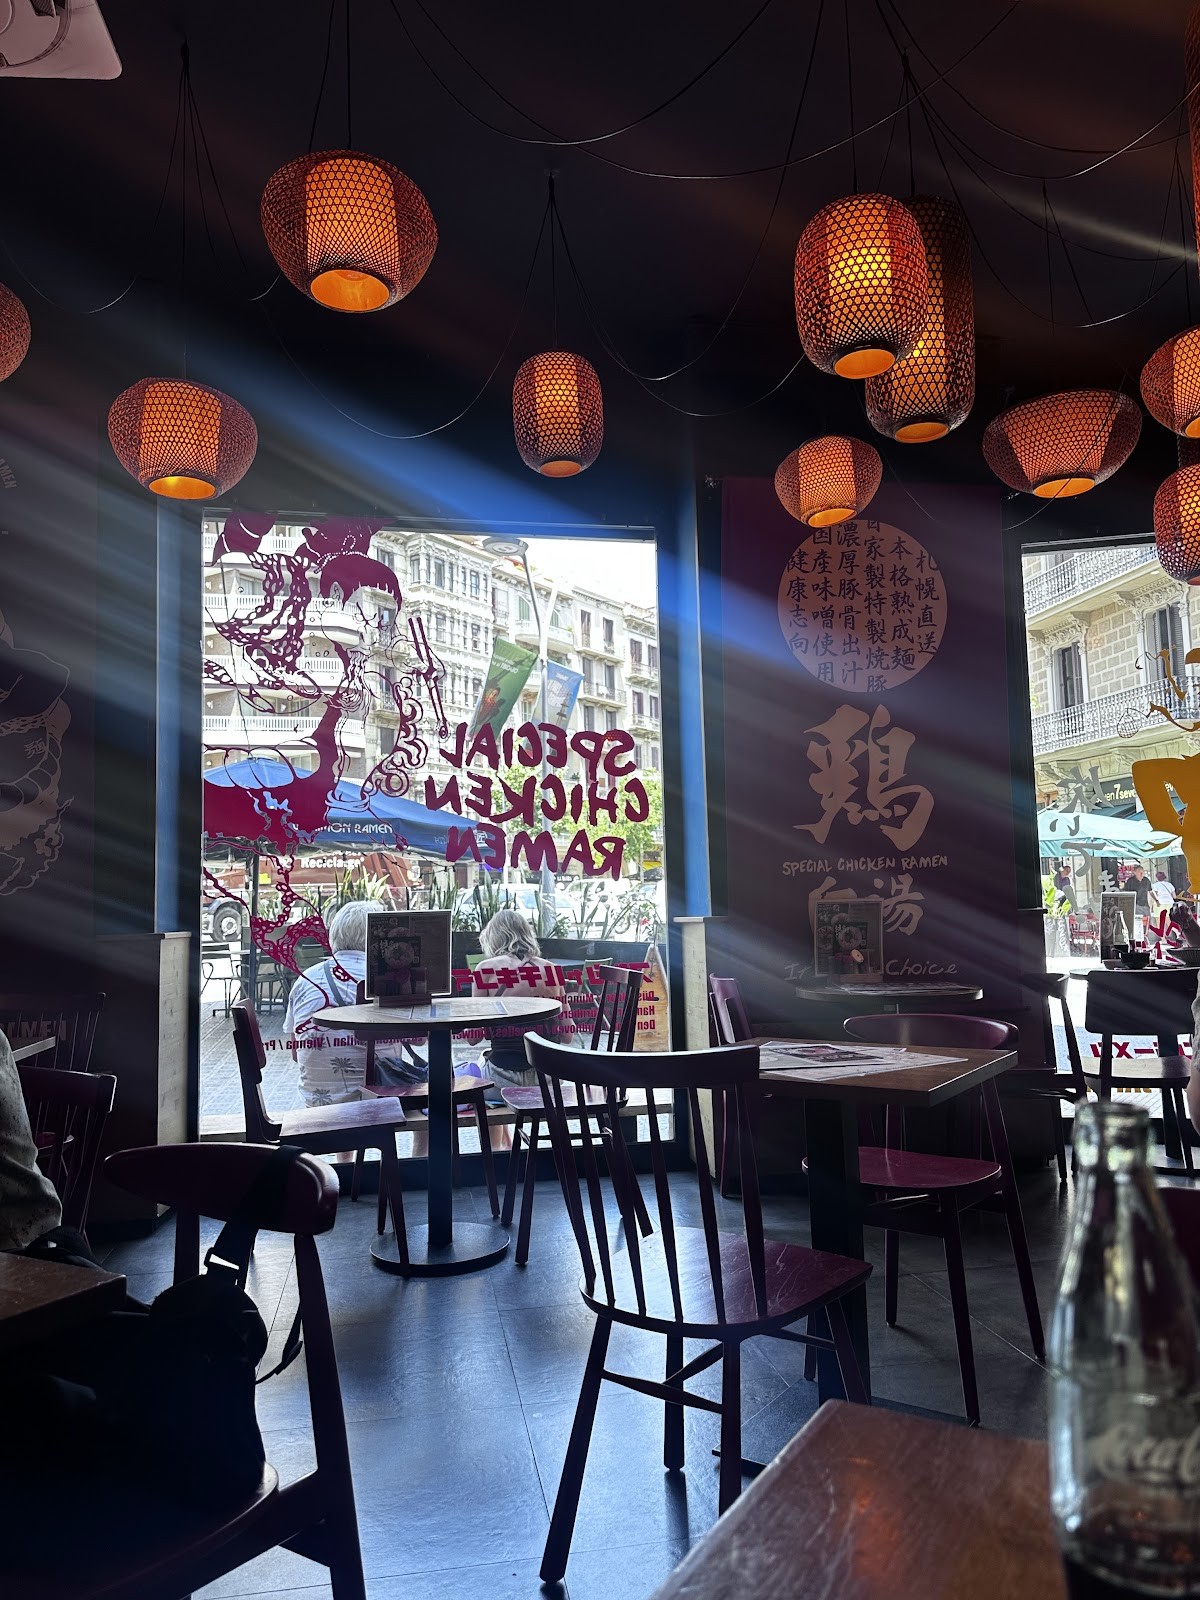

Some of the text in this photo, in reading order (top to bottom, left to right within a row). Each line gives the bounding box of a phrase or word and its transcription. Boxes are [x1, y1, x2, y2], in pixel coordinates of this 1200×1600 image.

[354, 823, 393, 835] RAMEN
[782, 854, 949, 877] SPECIAL CHICKEN RAMEN
